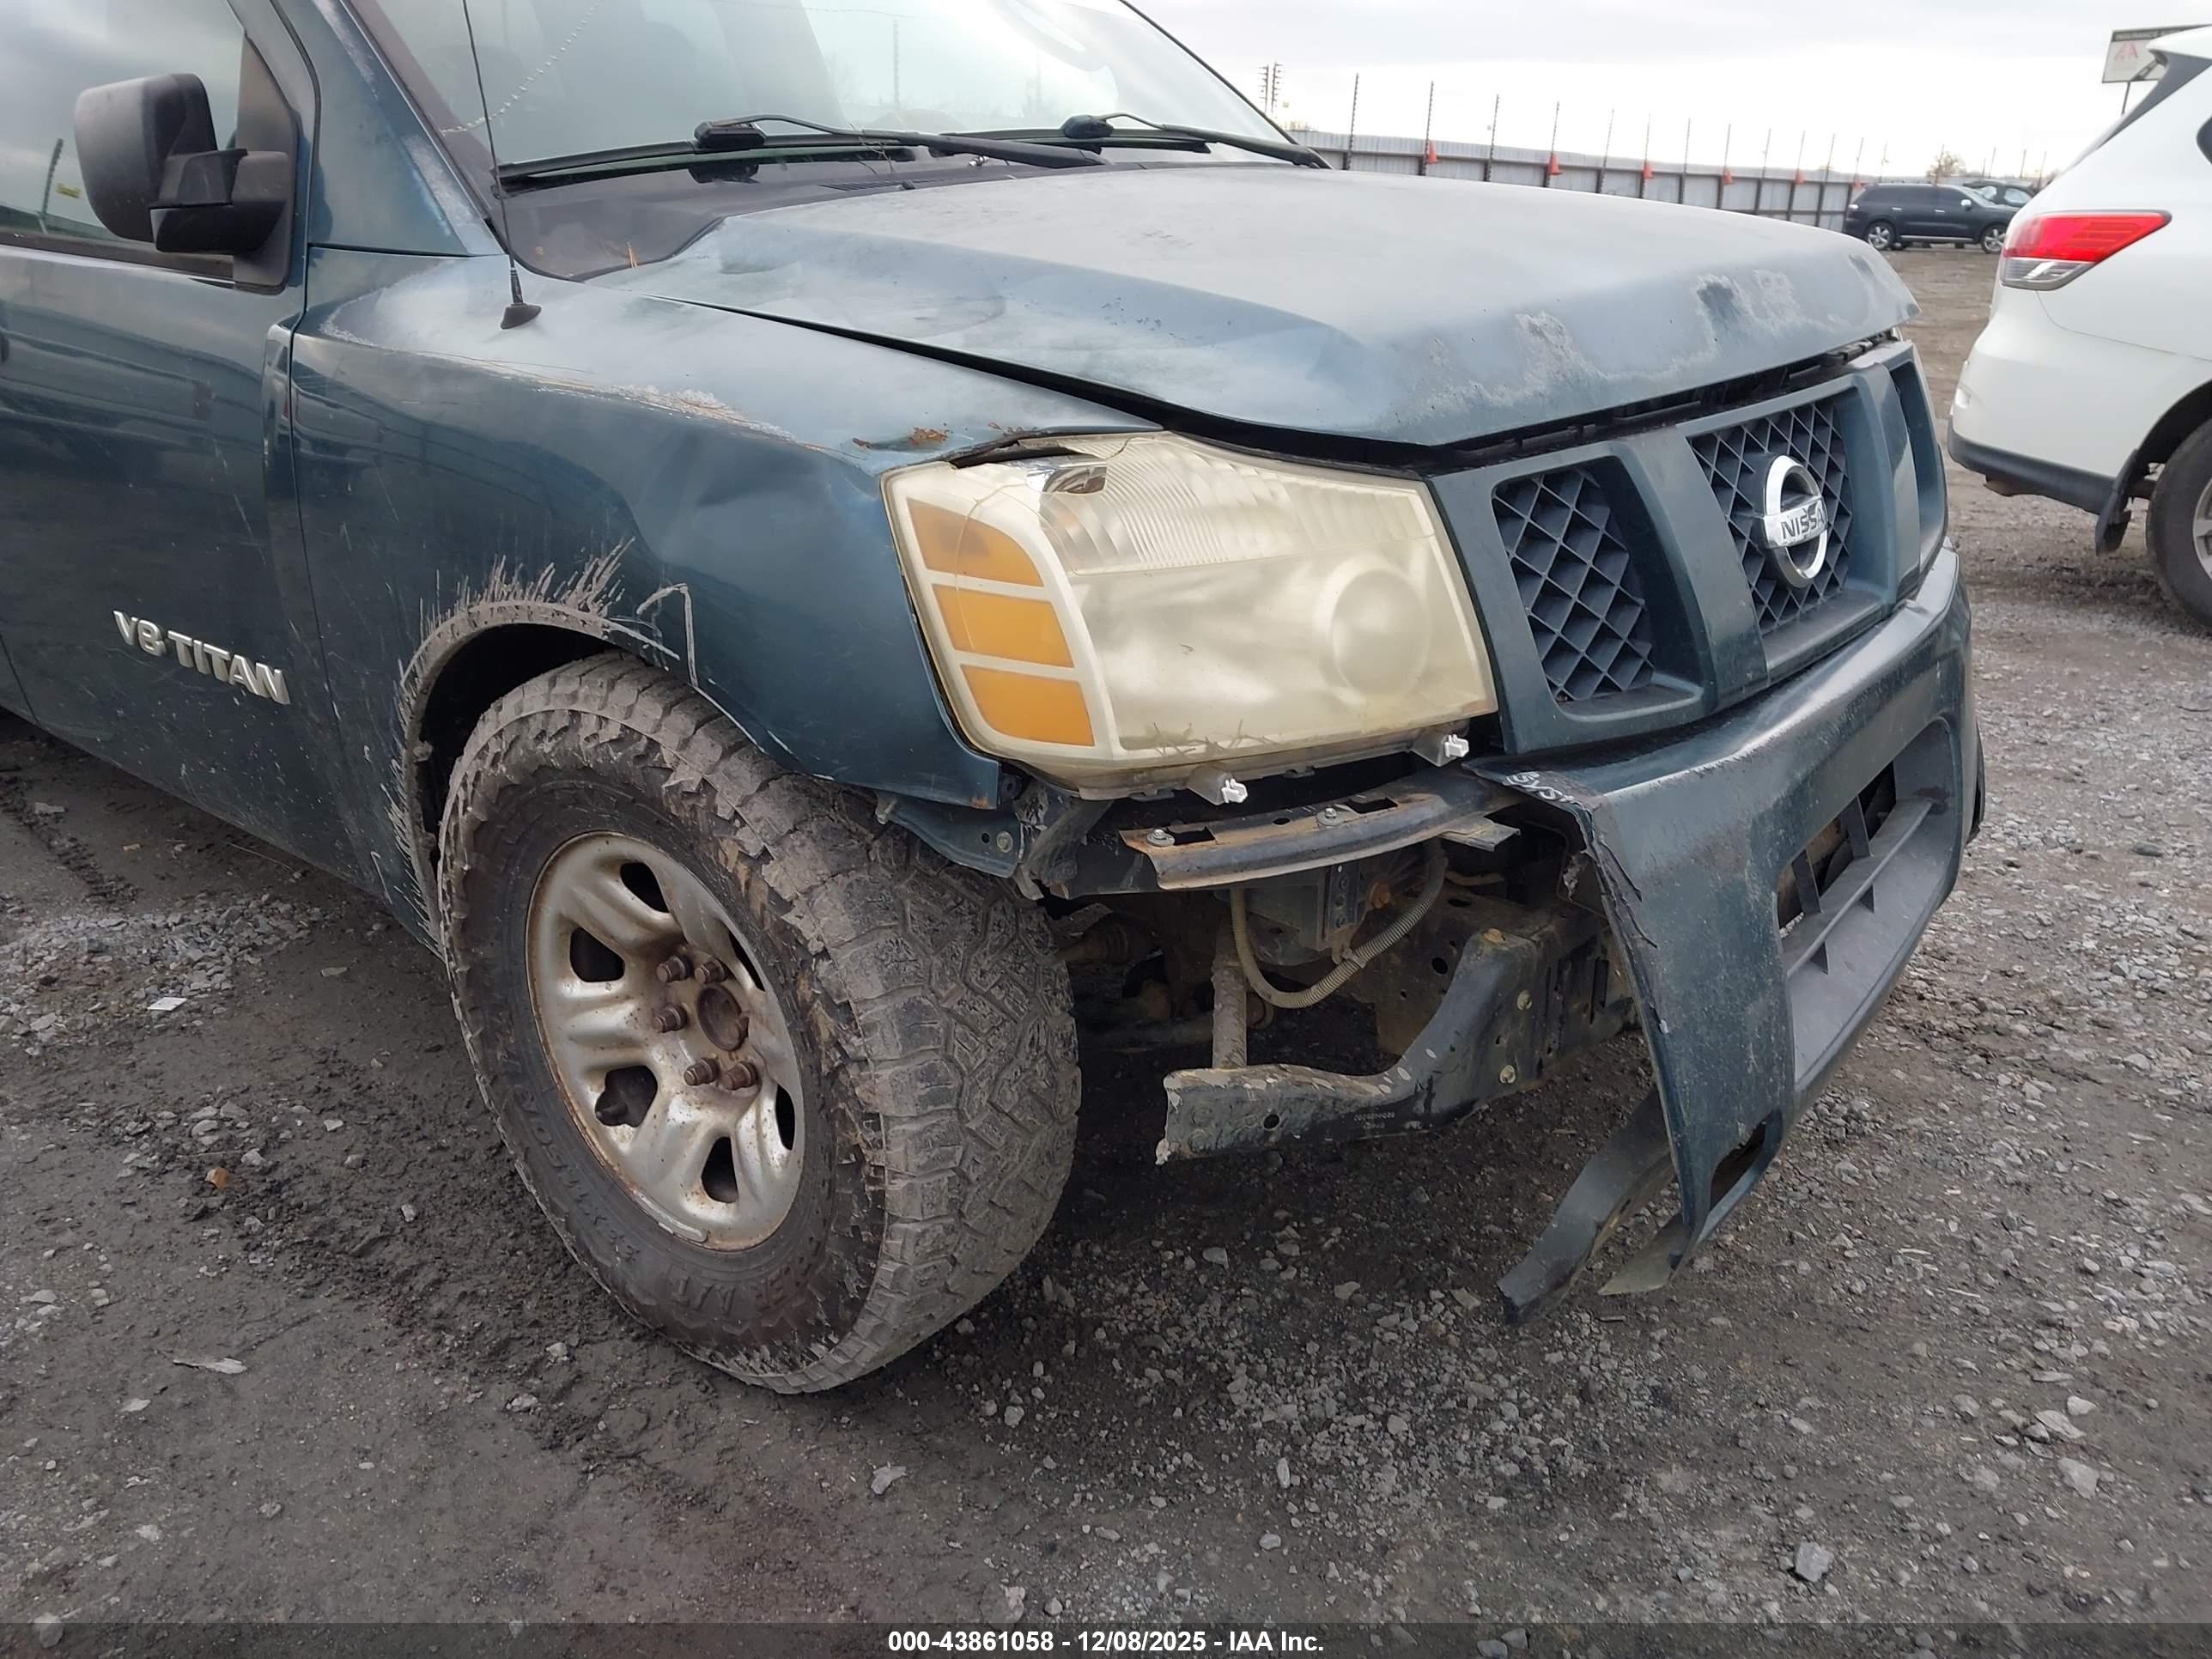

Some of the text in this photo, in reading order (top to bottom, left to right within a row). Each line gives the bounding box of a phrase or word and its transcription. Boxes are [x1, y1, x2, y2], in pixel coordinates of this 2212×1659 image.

[1780, 506, 1827, 539] NISSA
[113, 610, 291, 705] V8 TITAN
